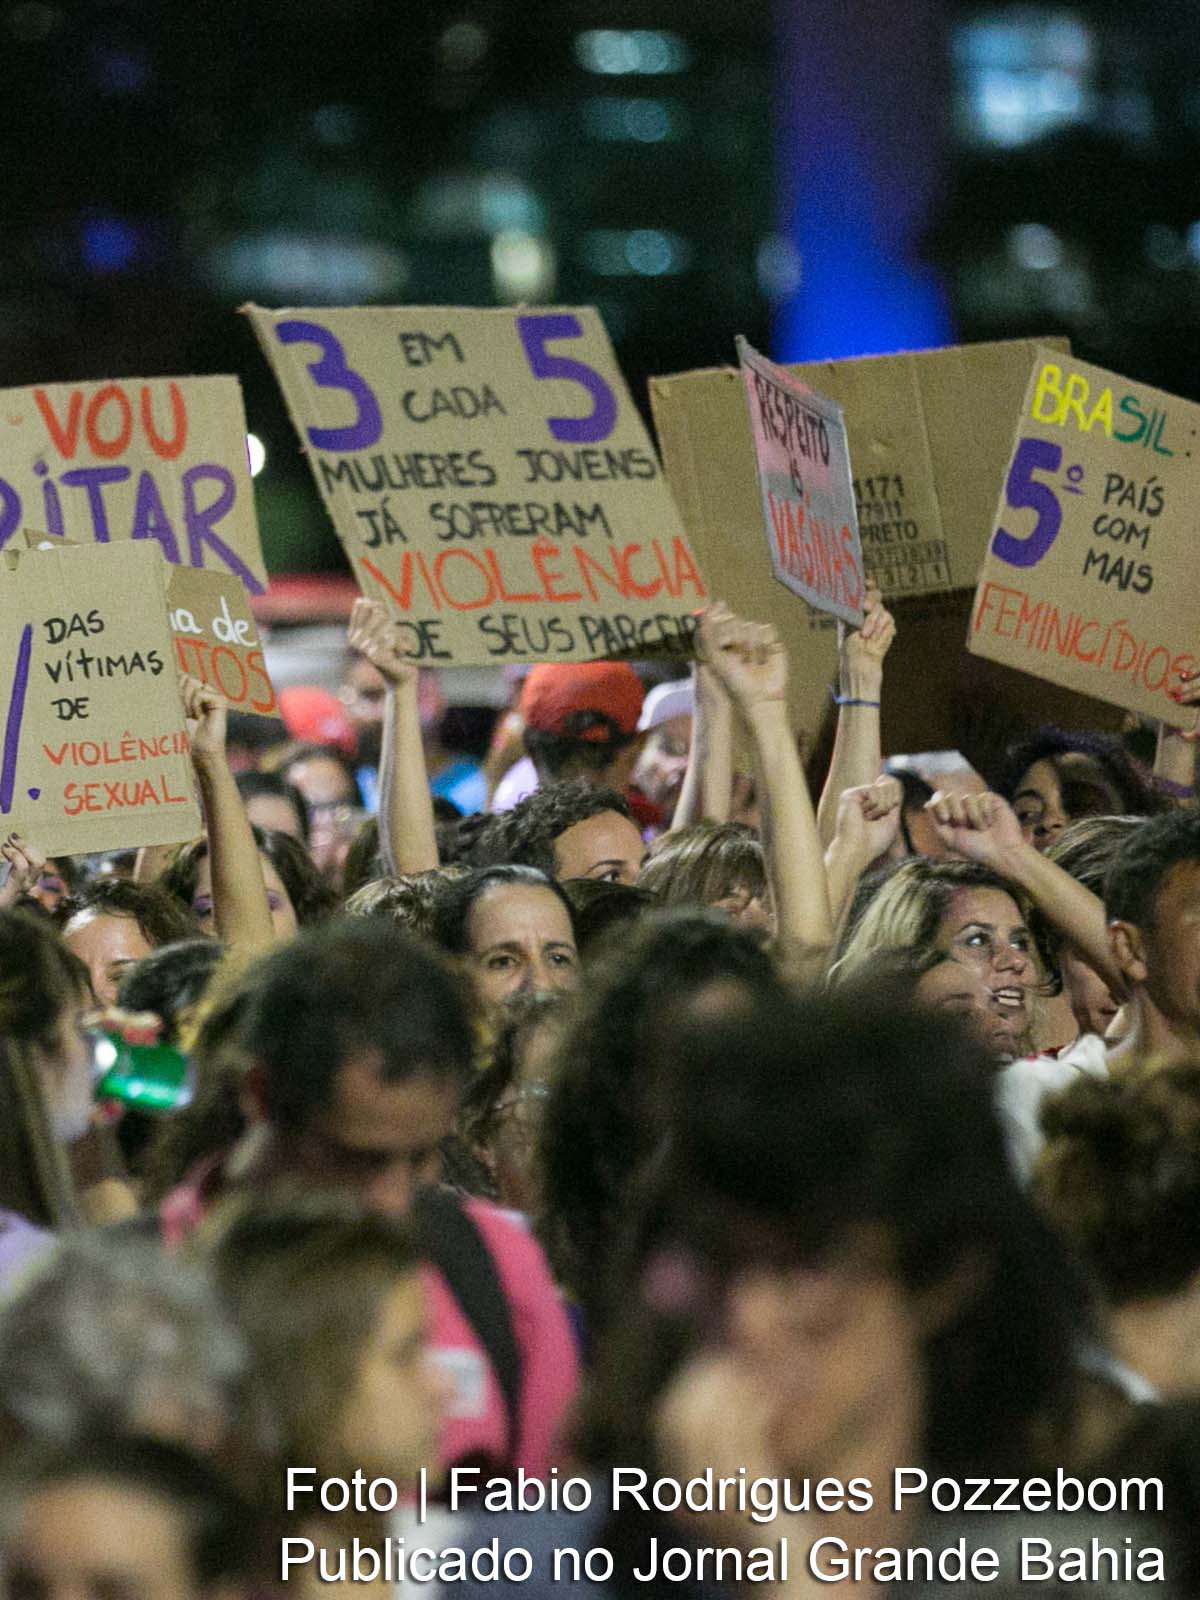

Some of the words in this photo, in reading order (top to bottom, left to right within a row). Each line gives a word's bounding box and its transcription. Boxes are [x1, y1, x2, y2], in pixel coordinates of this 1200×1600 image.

[273, 320, 384, 452] 3
[400, 331, 465, 367] EM
[515, 314, 619, 444] 5
[401, 384, 508, 423] CADA
[33, 381, 188, 461] VOU
[318, 449, 497, 494] MULHERES
[517, 447, 657, 484] JOVENS
[1103, 472, 1164, 518] PAÍS
[356, 498, 408, 549] JÁ
[428, 500, 613, 541] SOFRERAM
[1093, 513, 1151, 550] COM
[360, 534, 708, 612] VIOLÊNCIA
[1083, 547, 1154, 595] MAIS
[43, 609, 105, 645] DAS
[212, 595, 257, 647] de
[477, 614, 575, 656] SEUS
[51, 697, 90, 721] DE
[42, 731, 190, 767] VIOLÊNCIA
[63, 775, 188, 815] SEXUAL
